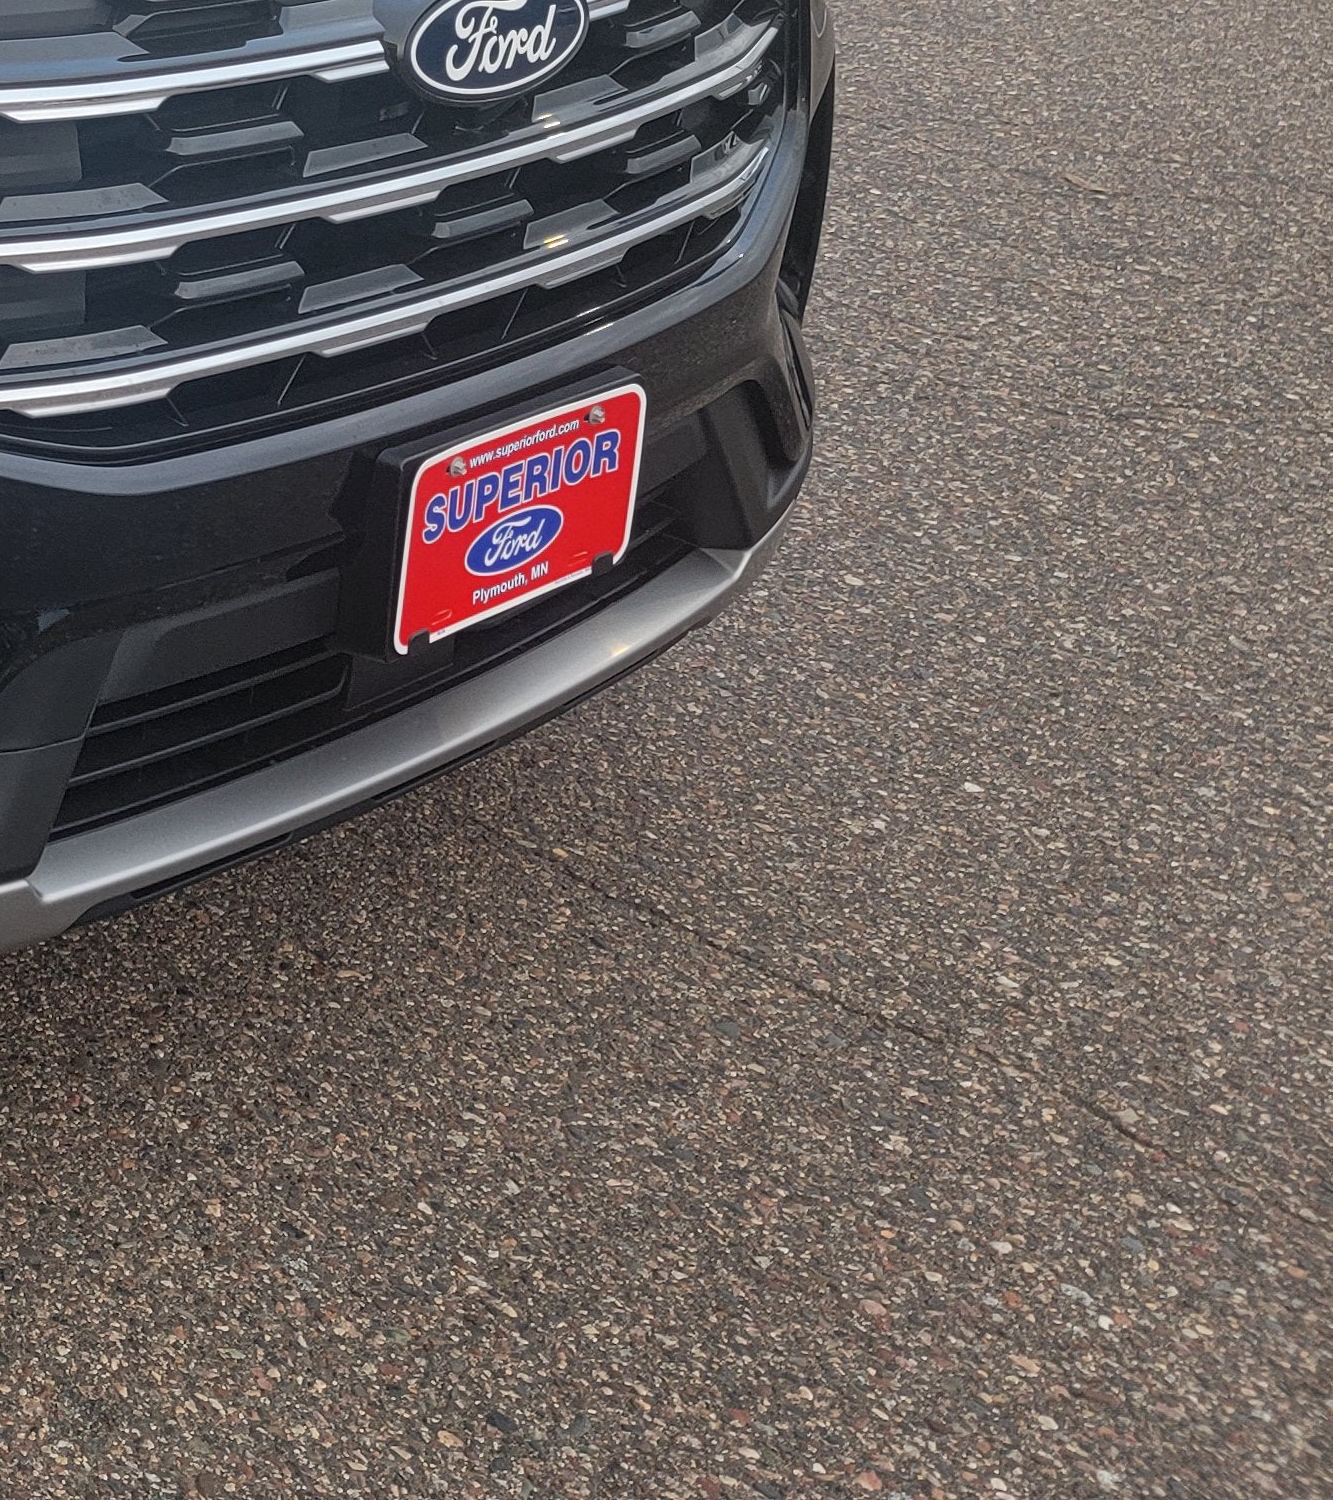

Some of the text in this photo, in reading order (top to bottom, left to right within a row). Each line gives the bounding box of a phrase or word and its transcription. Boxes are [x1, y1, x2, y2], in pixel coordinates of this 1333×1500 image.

[469, 418, 580, 469] www.superiorford.com
[421, 428, 621, 545] SUPERIOR
[483, 516, 546, 567] Ford
[472, 572, 528, 605] Plymouth,
[530, 560, 550, 581] MN
